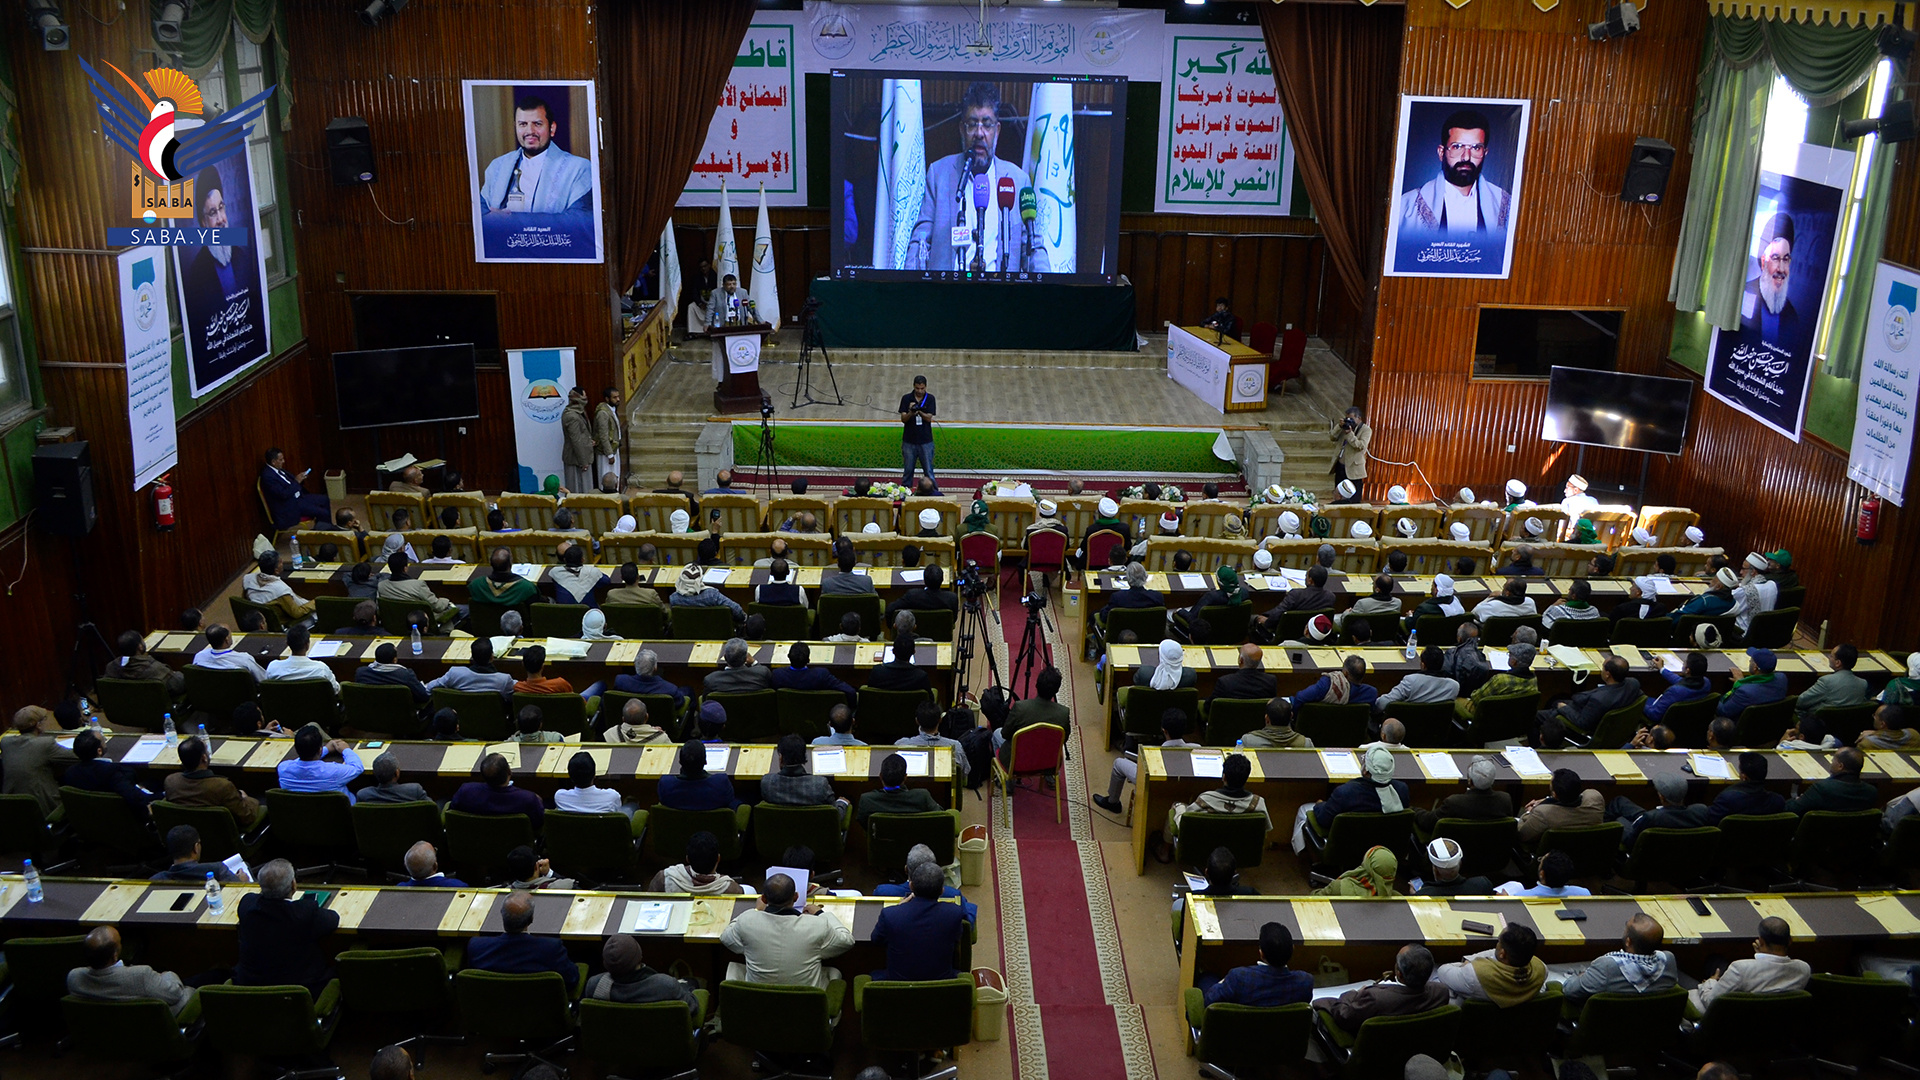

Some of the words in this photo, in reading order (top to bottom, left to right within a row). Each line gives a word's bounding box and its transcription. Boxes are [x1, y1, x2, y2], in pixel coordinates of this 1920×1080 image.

[1178, 43, 1245, 82] أكبر
[740, 83, 787, 112] البضائع
[1178, 81, 1233, 106] لأمريكا
[1237, 87, 1281, 107] لموت
[730, 118, 738, 140] و
[1175, 113, 1231, 136] لإسرائيل
[1235, 115, 1280, 136] الموت
[1173, 142, 1213, 163] اليهود
[1216, 142, 1238, 164] على
[1243, 142, 1278, 161] اللعنة
[692, 150, 789, 178] الإسرائيلي
[1171, 167, 1225, 199] للإسلام
[1227, 167, 1276, 198] النصر
[1873, 358, 1884, 369] الله
[1869, 377, 1892, 393] للعالمين
[1892, 385, 1907, 400] رحمة
[1865, 393, 1881, 408] يهتدي
[1865, 428, 1888, 444] الظلمات
